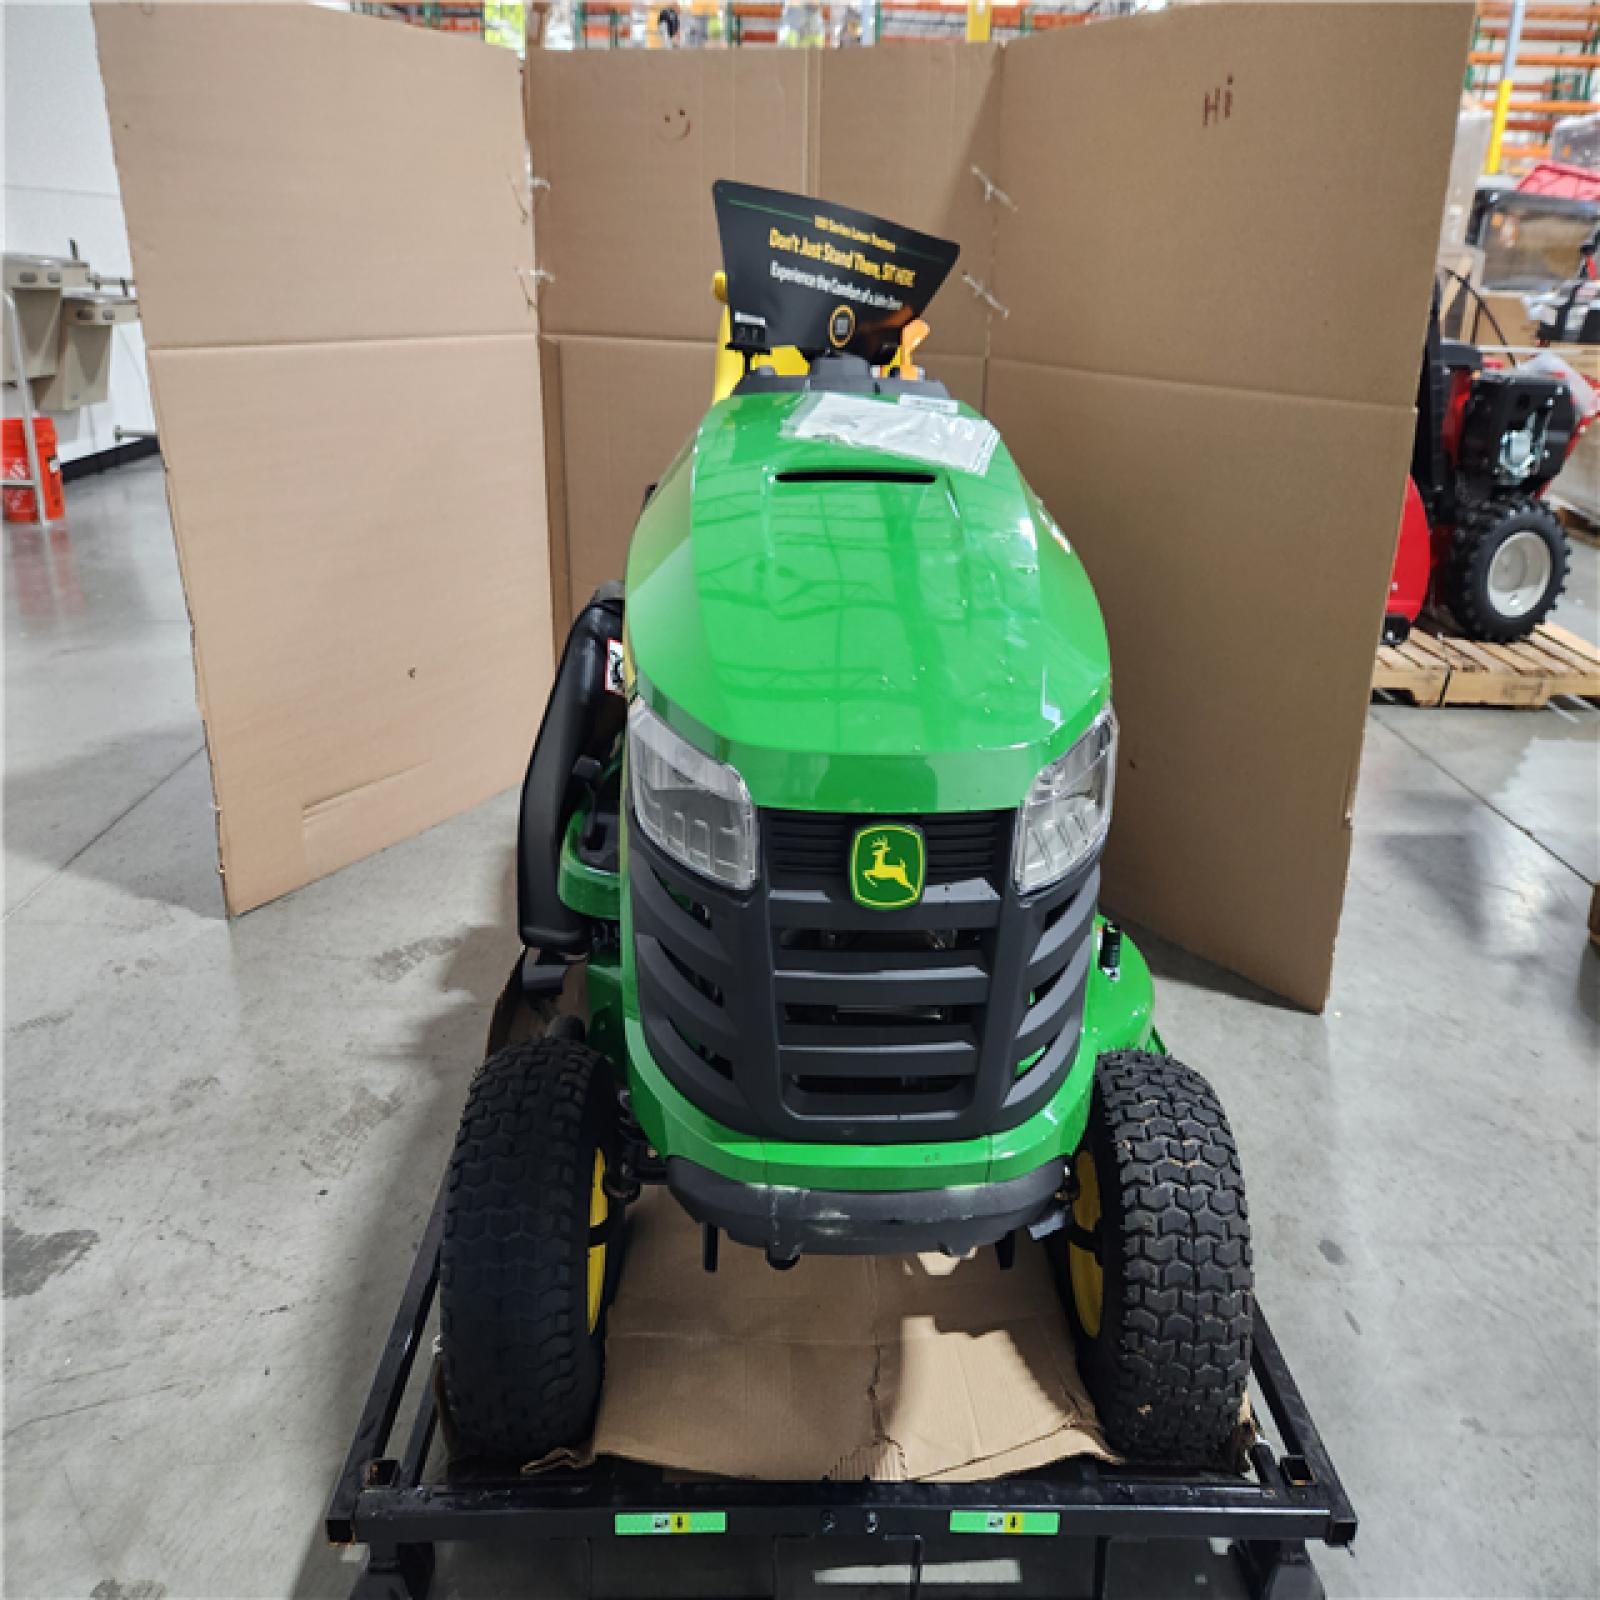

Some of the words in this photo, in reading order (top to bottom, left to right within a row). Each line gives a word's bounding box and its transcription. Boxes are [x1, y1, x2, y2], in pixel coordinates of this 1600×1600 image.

[1203, 74, 1233, 128] Hi
[770, 228, 800, 253] Don't
[800, 236, 822, 260] Just
[824, 240, 853, 269] Stand
[770, 260, 815, 286] Experience
